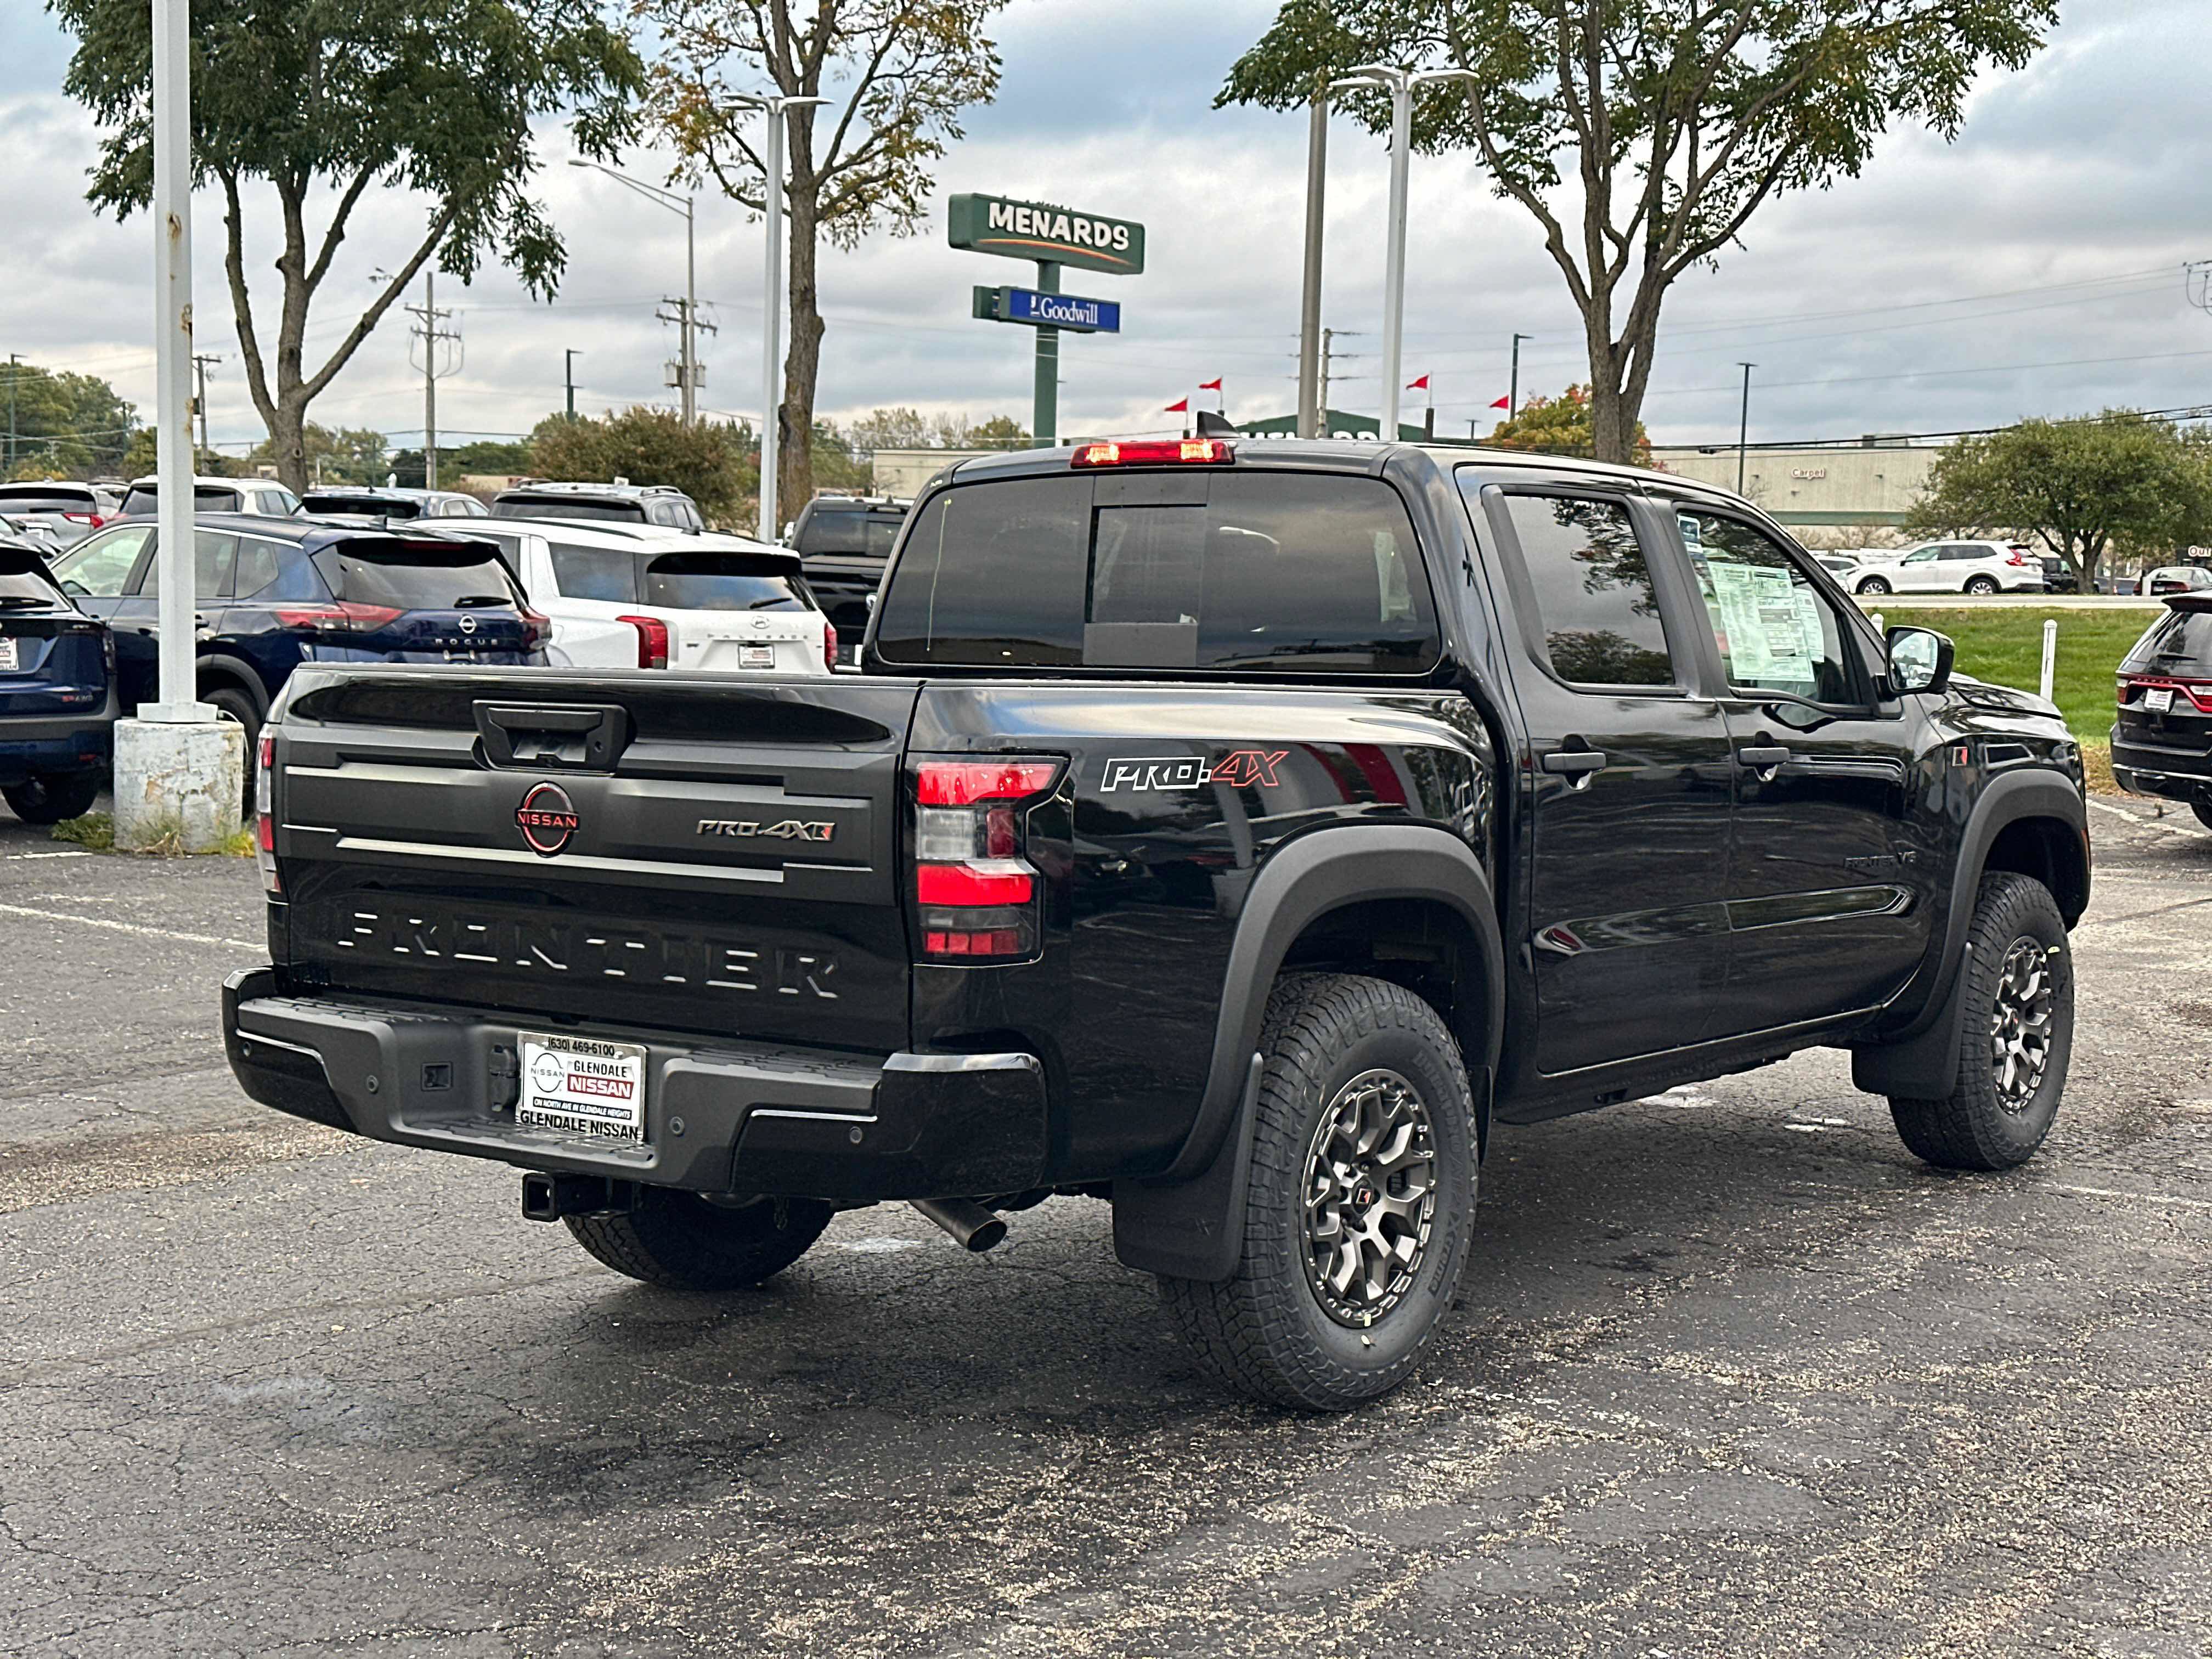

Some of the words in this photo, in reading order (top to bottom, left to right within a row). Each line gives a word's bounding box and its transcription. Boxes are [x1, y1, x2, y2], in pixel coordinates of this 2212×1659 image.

[988, 201, 1129, 251] MENARDS
[1041, 297, 1098, 324] Goodwill
[1791, 468, 1825, 479] Carpet
[517, 812, 577, 828] NISSAN
[336, 907, 838, 998] FRONTIER
[549, 1037, 570, 1052] (630)
[572, 1041, 615, 1057] 469-6100
[531, 1068, 565, 1078] NISSAN
[574, 1060, 628, 1078] GLENDALE
[569, 1076, 631, 1098] NISSAN
[534, 1098, 543, 1107] ON
[543, 1099, 561, 1109] NORTH
[561, 1103, 572, 1111] AVE
[579, 1104, 607, 1115] GLENDALE
[607, 1108, 630, 1119] HEIGHTS
[521, 1110, 586, 1132] GLENDALE
[590, 1121, 639, 1141] NISSAN
